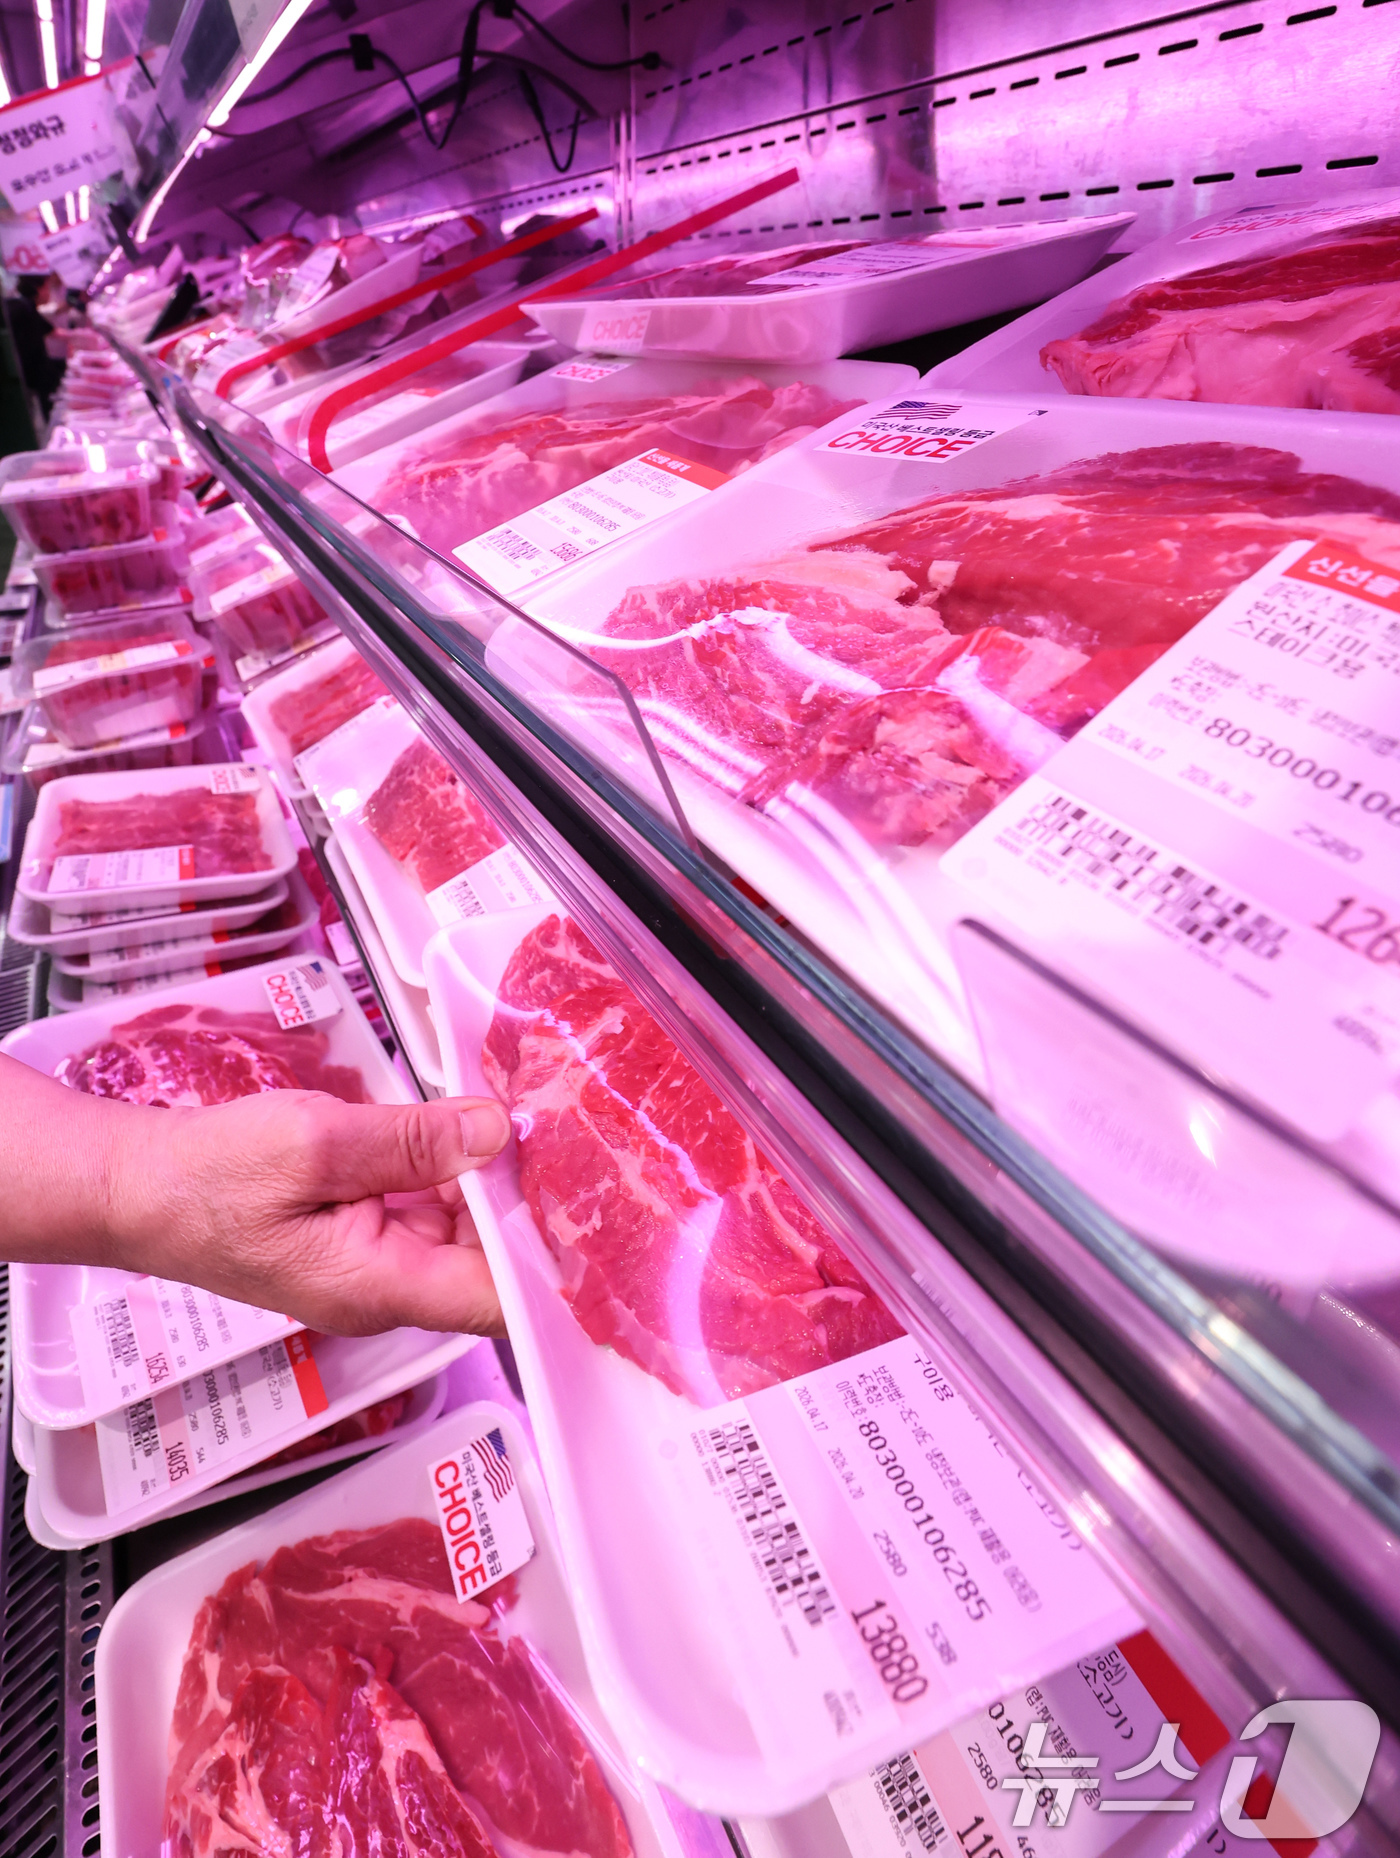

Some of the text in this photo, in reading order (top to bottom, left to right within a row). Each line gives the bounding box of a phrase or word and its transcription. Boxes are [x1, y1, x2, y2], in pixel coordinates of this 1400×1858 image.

[827, 430, 976, 459] CHOICE
[896, 423, 964, 437] 베스트셀링
[267, 973, 305, 1026] CHOICE
[913, 1353, 955, 1402] 구이용
[165, 1441, 189, 1483] 14035
[434, 1460, 488, 1596] CHOICE
[461, 1450, 503, 1578] 미국산 베스트셀링 등급
[794, 1386, 830, 1432] 2026.04.17
[872, 1531, 909, 1578] 2580
[925, 1621, 958, 1667] 538
[859, 1420, 993, 1622] 803000106285
[850, 1598, 929, 1704] 13880
[1076, 1660, 1134, 1740] (소고기)
[967, 1741, 999, 1791] 2580
